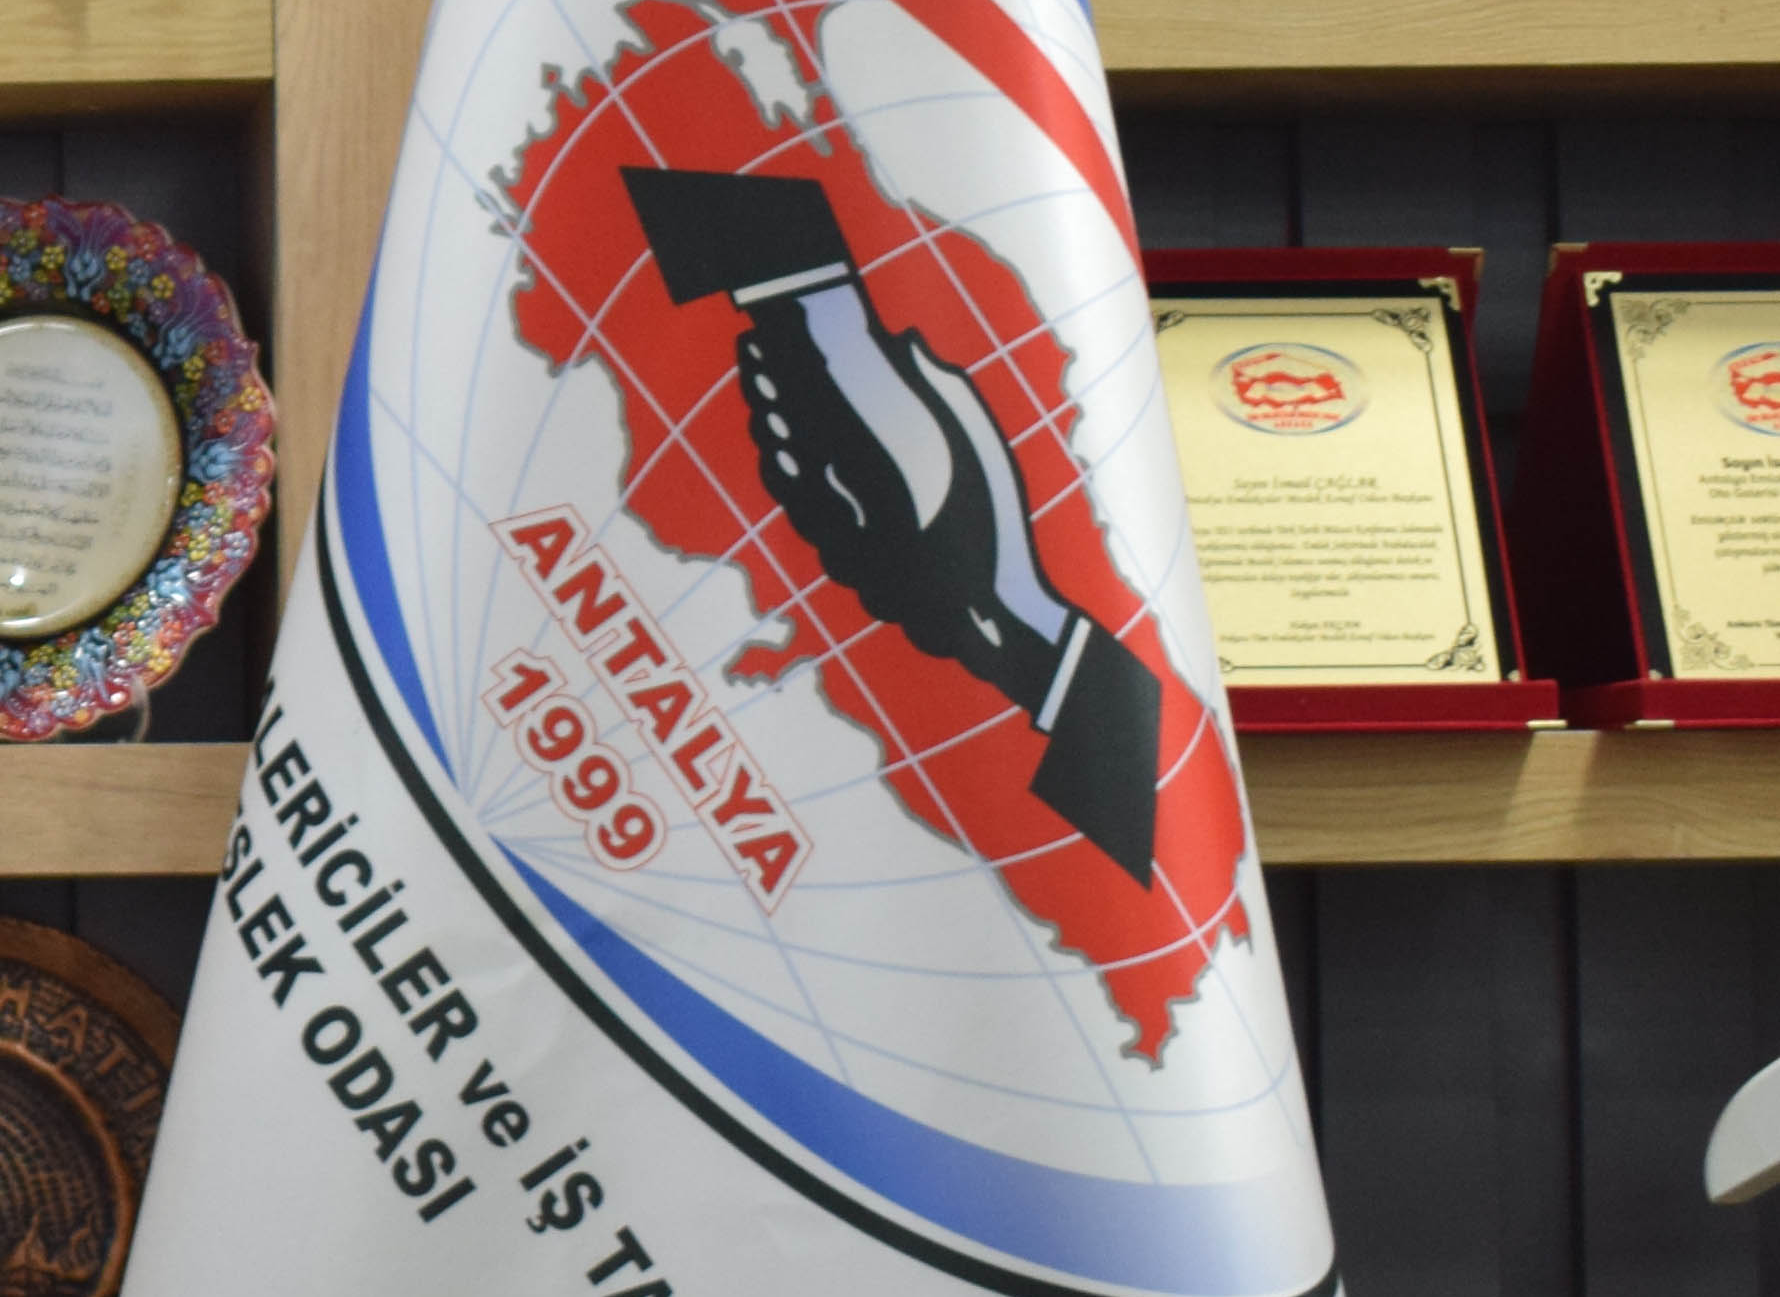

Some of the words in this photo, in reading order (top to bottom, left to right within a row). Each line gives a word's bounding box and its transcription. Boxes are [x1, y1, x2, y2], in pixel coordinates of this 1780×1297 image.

[496, 663, 656, 860] 1999
[509, 516, 800, 895] ANTALYA
[222, 806, 325, 1010] SLEK
[300, 1005, 477, 1222] ODASI
[254, 676, 479, 1063] LERİCİLER
[457, 1058, 531, 1149] ve
[519, 1137, 605, 1234] İŞ
